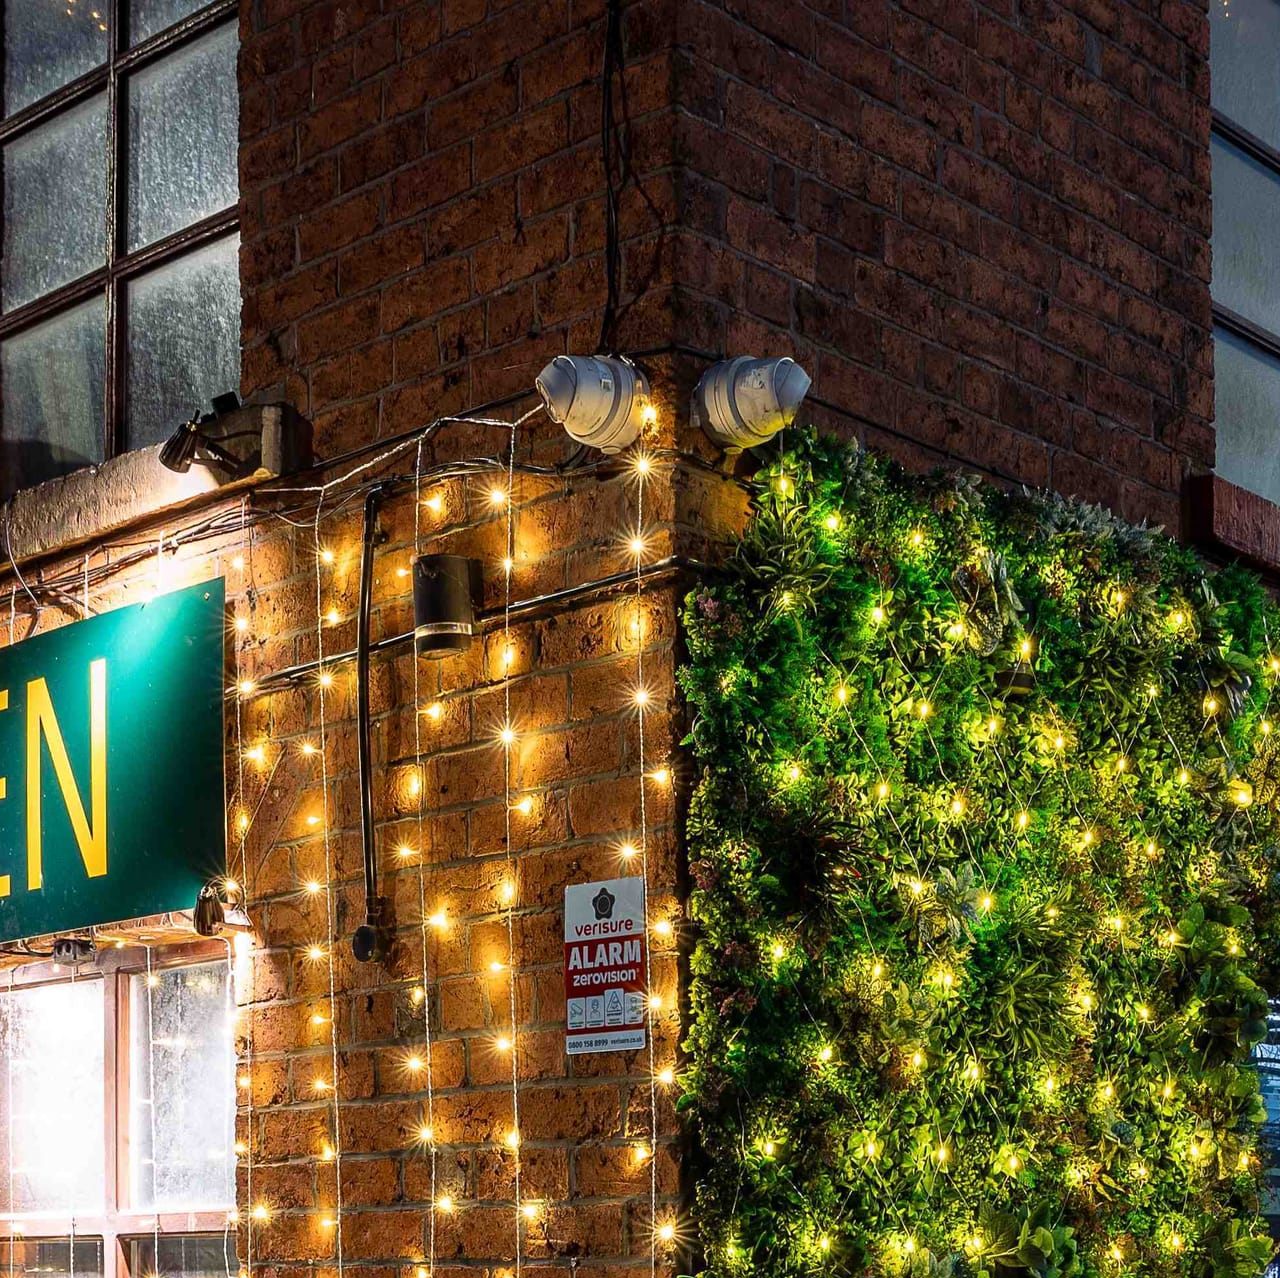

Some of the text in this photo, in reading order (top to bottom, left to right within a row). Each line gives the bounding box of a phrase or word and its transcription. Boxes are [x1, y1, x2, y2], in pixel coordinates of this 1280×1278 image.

[575, 918, 633, 937] verisure
[568, 939, 641, 971] ALARM
[573, 968, 637, 987] zerovision
